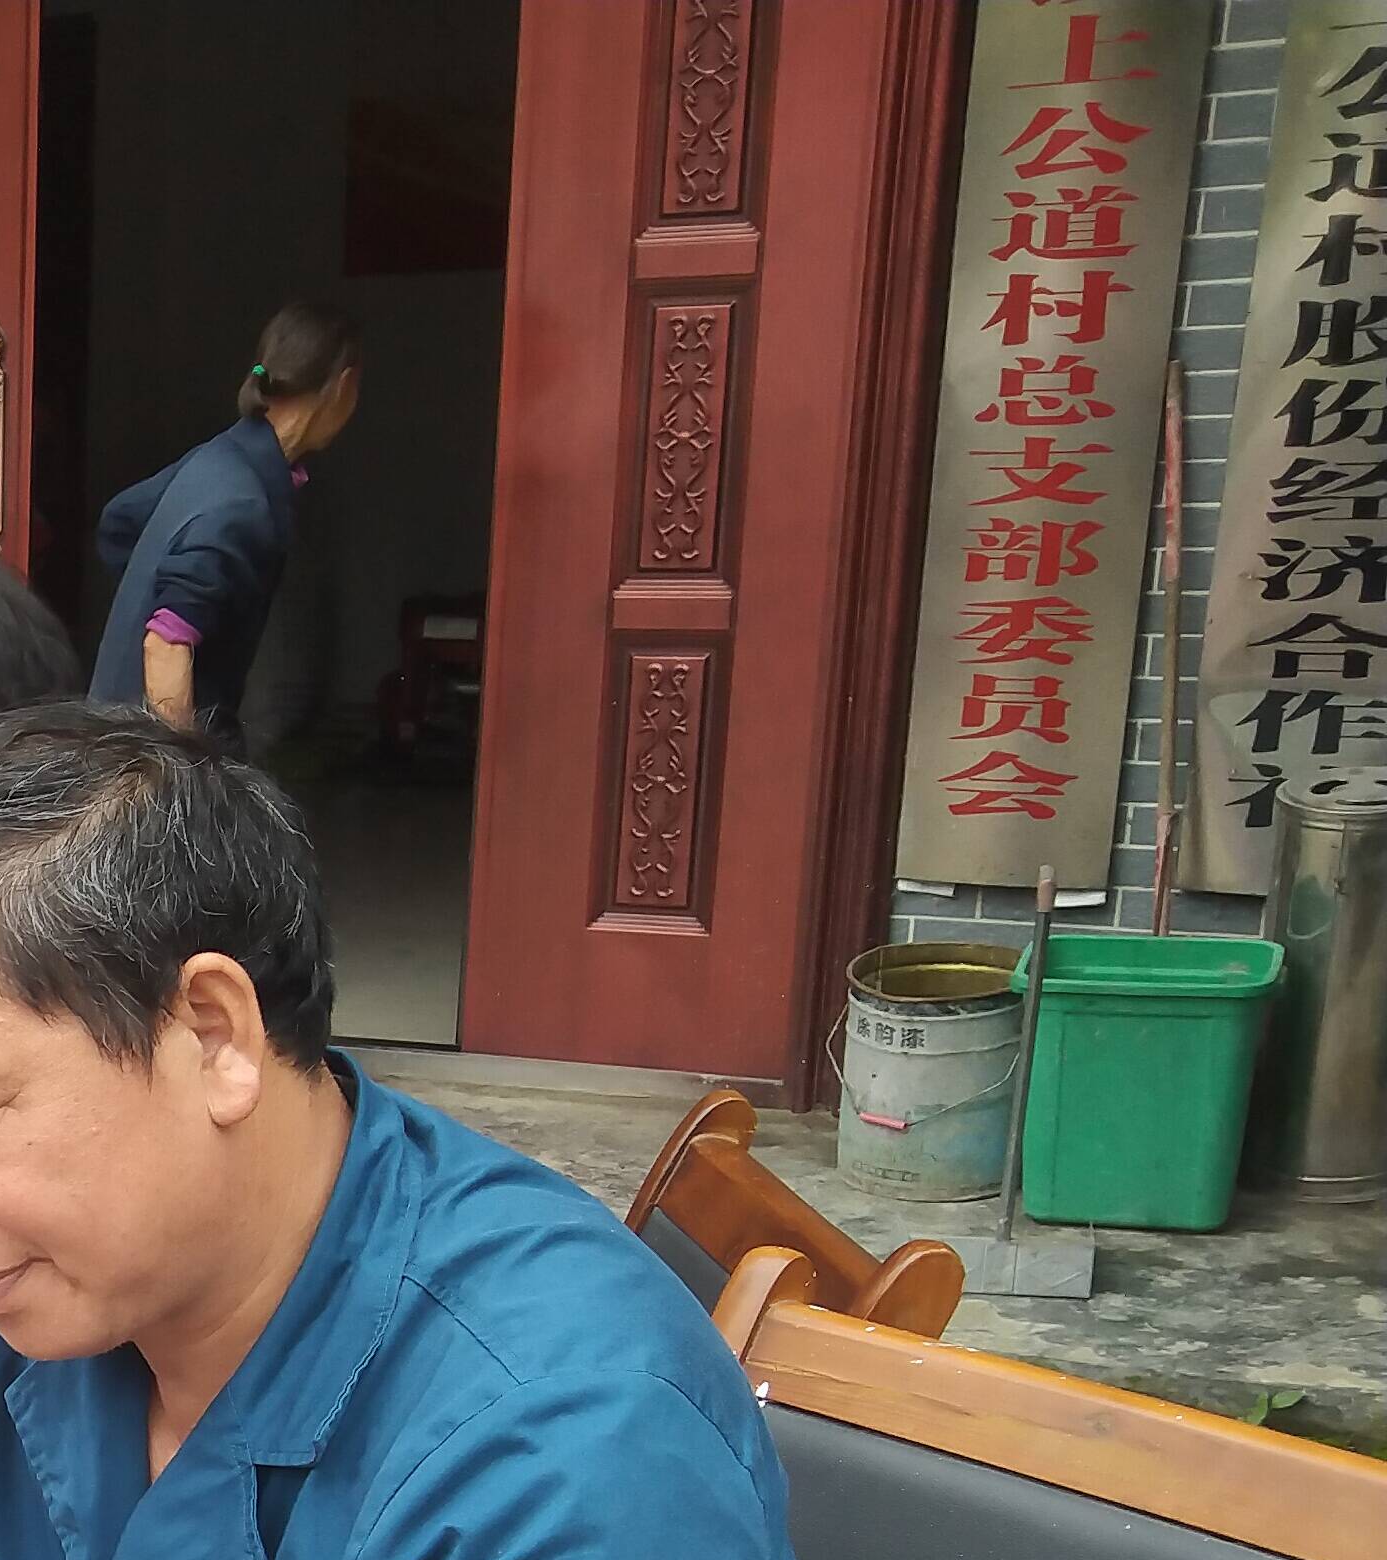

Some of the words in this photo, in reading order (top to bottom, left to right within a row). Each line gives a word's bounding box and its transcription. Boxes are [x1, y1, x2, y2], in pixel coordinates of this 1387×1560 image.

[937, 0, 1160, 820] 上公道村总支部委员会
[1224, 20, 1387, 830] 道村股份经济合作
